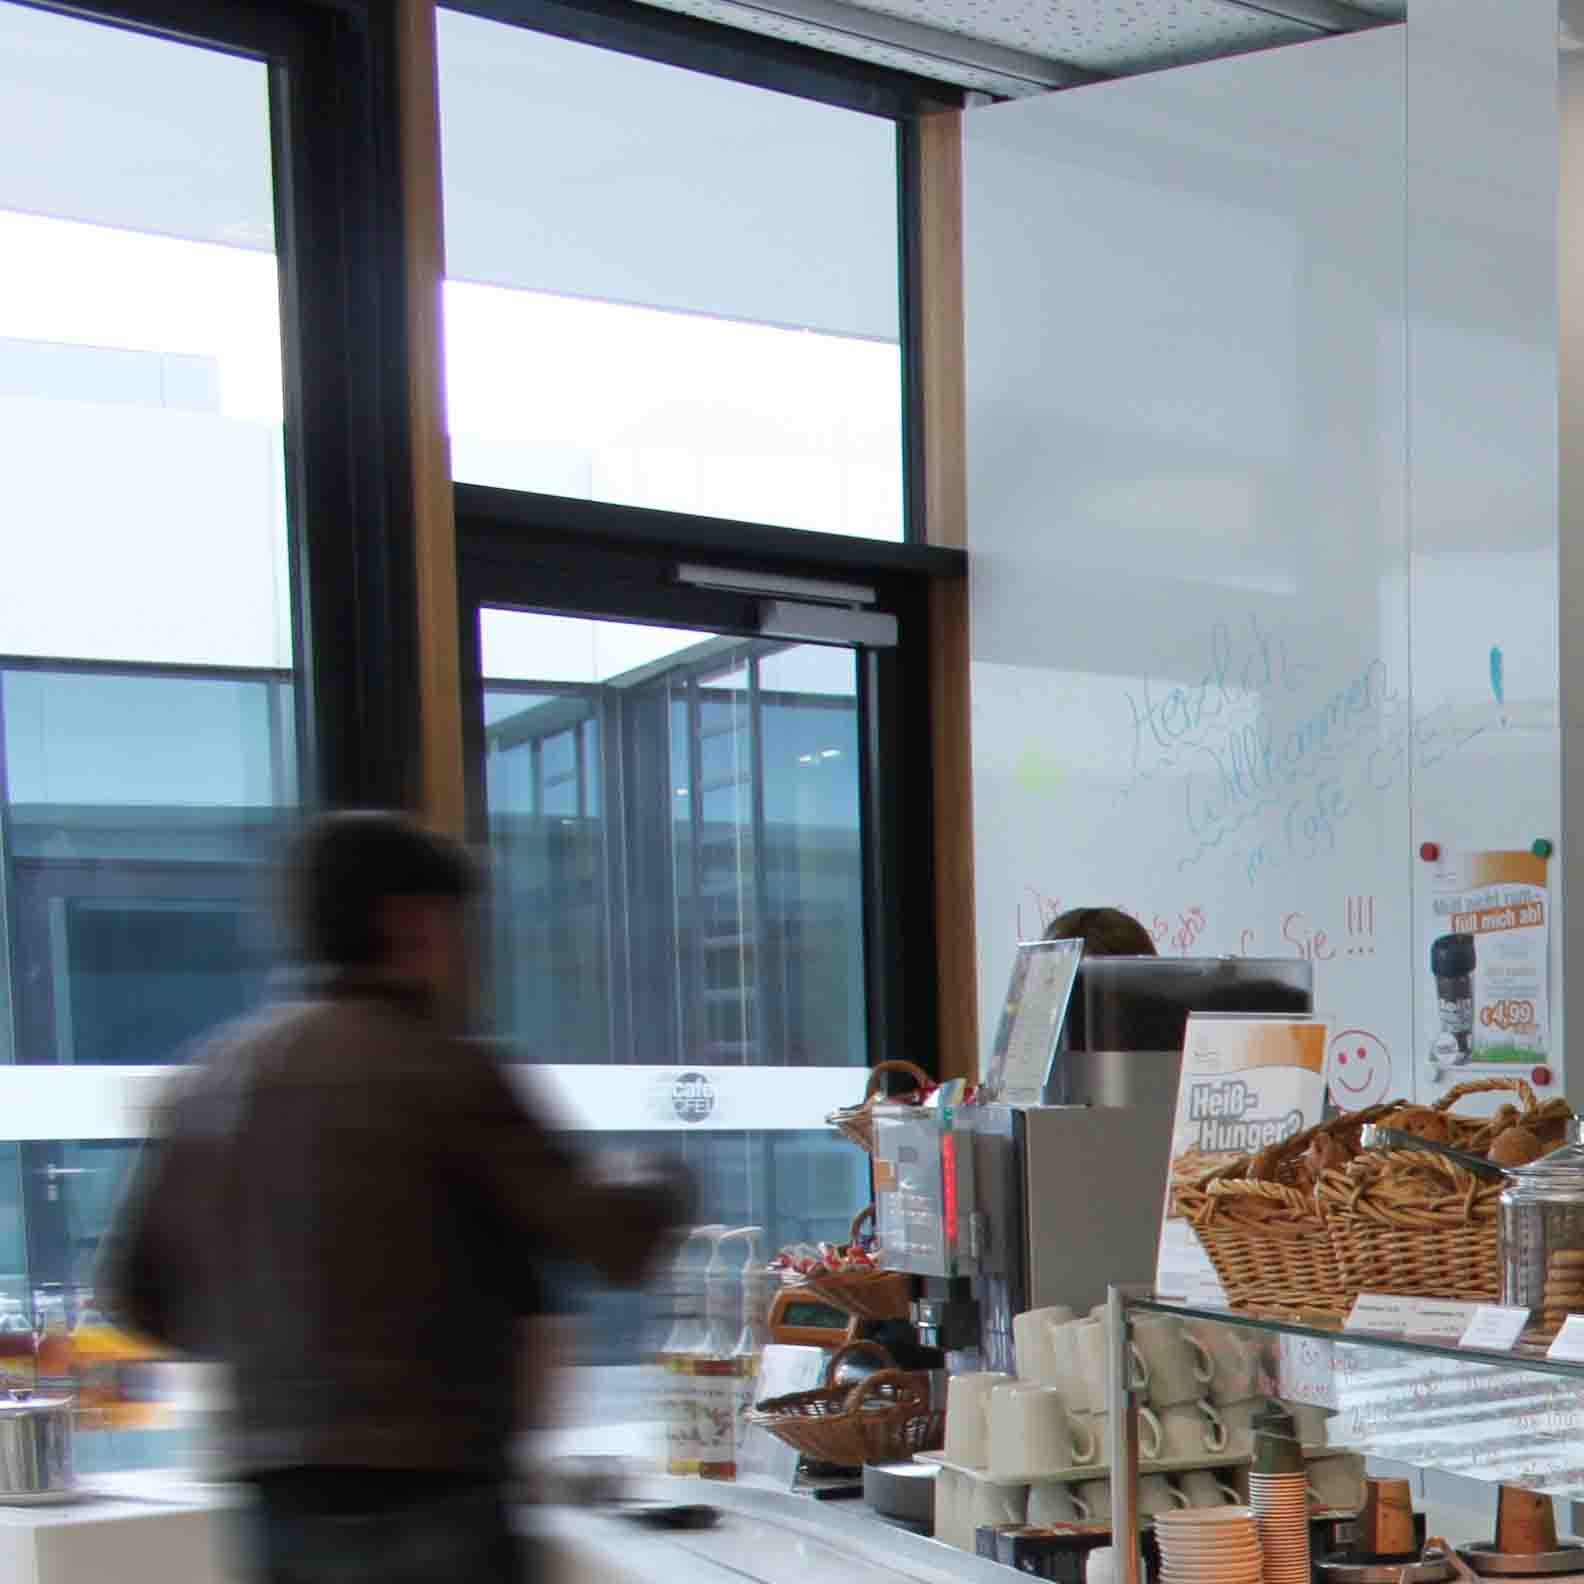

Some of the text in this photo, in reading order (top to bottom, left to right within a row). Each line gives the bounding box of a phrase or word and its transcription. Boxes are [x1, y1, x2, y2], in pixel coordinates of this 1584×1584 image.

[1283, 911, 1337, 962] Sie
[1190, 1080, 1259, 1121] Heiß-
[1200, 1110, 1304, 1155] Hunger?
